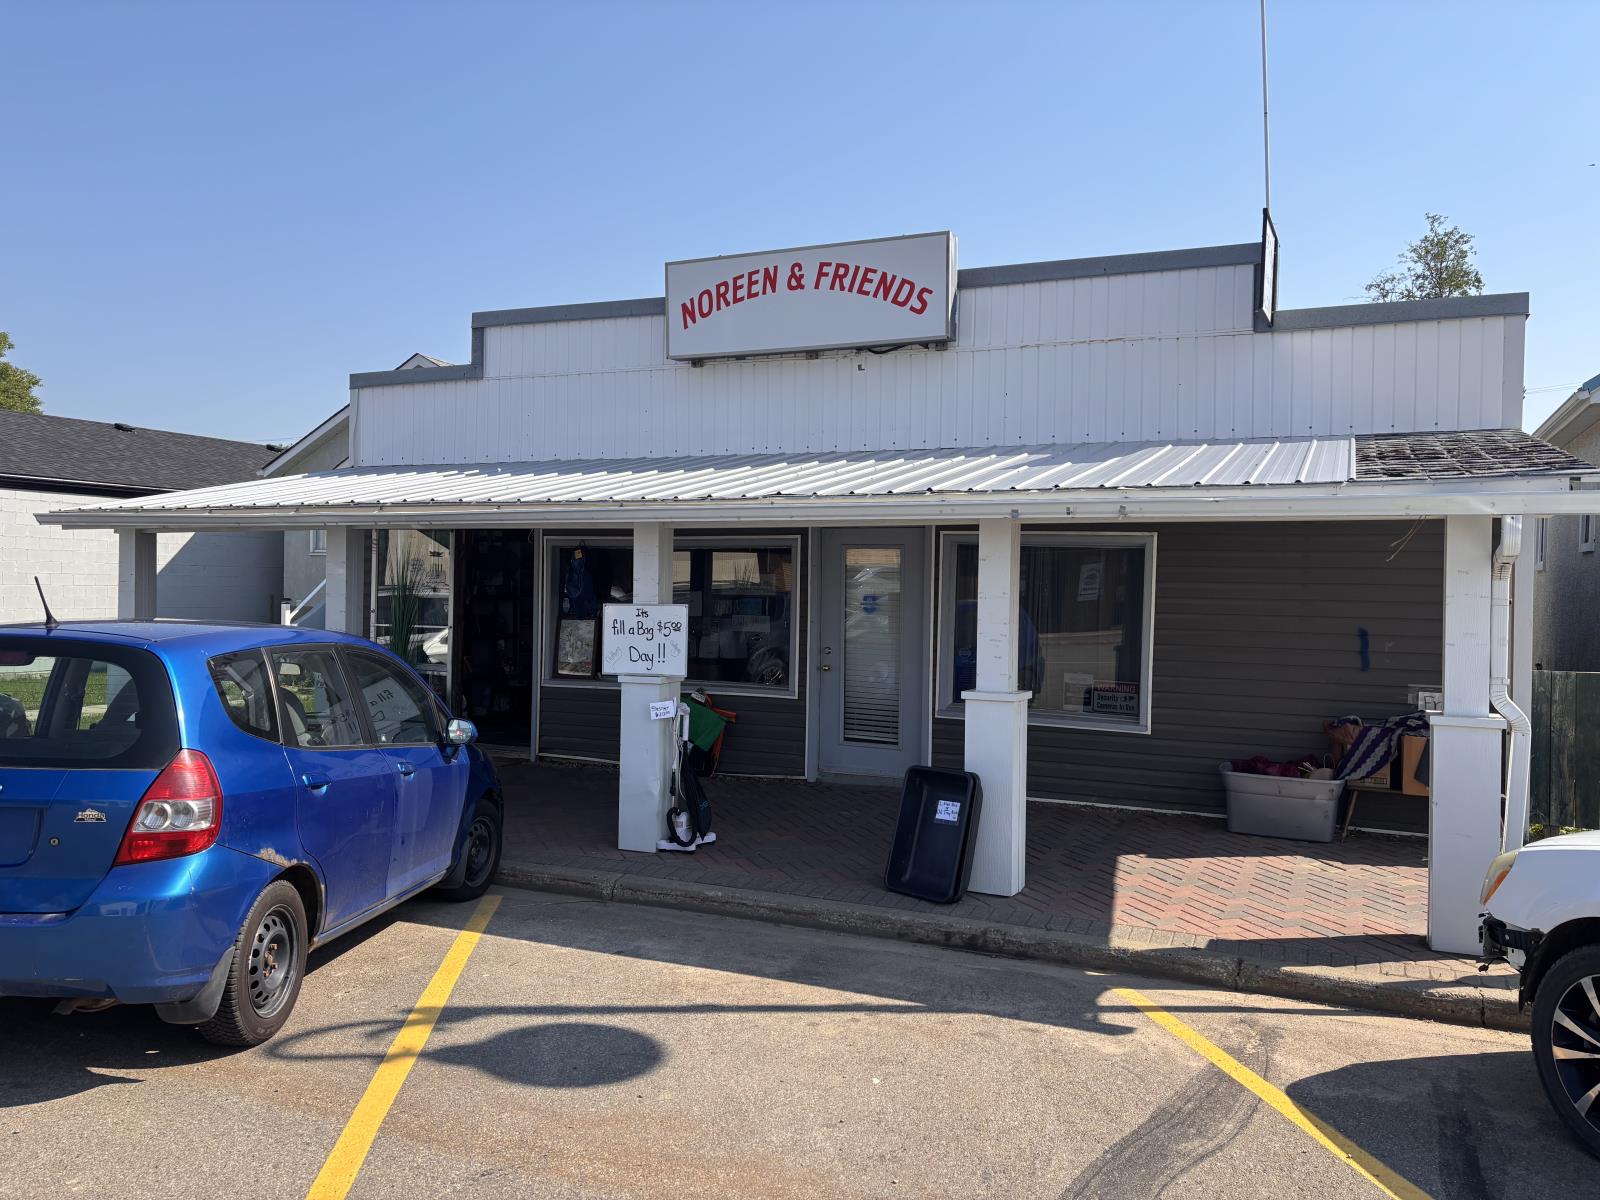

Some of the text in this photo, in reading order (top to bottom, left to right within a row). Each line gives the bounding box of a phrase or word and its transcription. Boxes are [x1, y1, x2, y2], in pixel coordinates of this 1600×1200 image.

[681, 261, 933, 330] NOREEN & FRIENDS
[612, 619, 625, 636] fill
[628, 628, 635, 636] a
[637, 620, 654, 641] Bag
[629, 646, 654, 670] Day
[1097, 684, 1136, 693] WARNING
